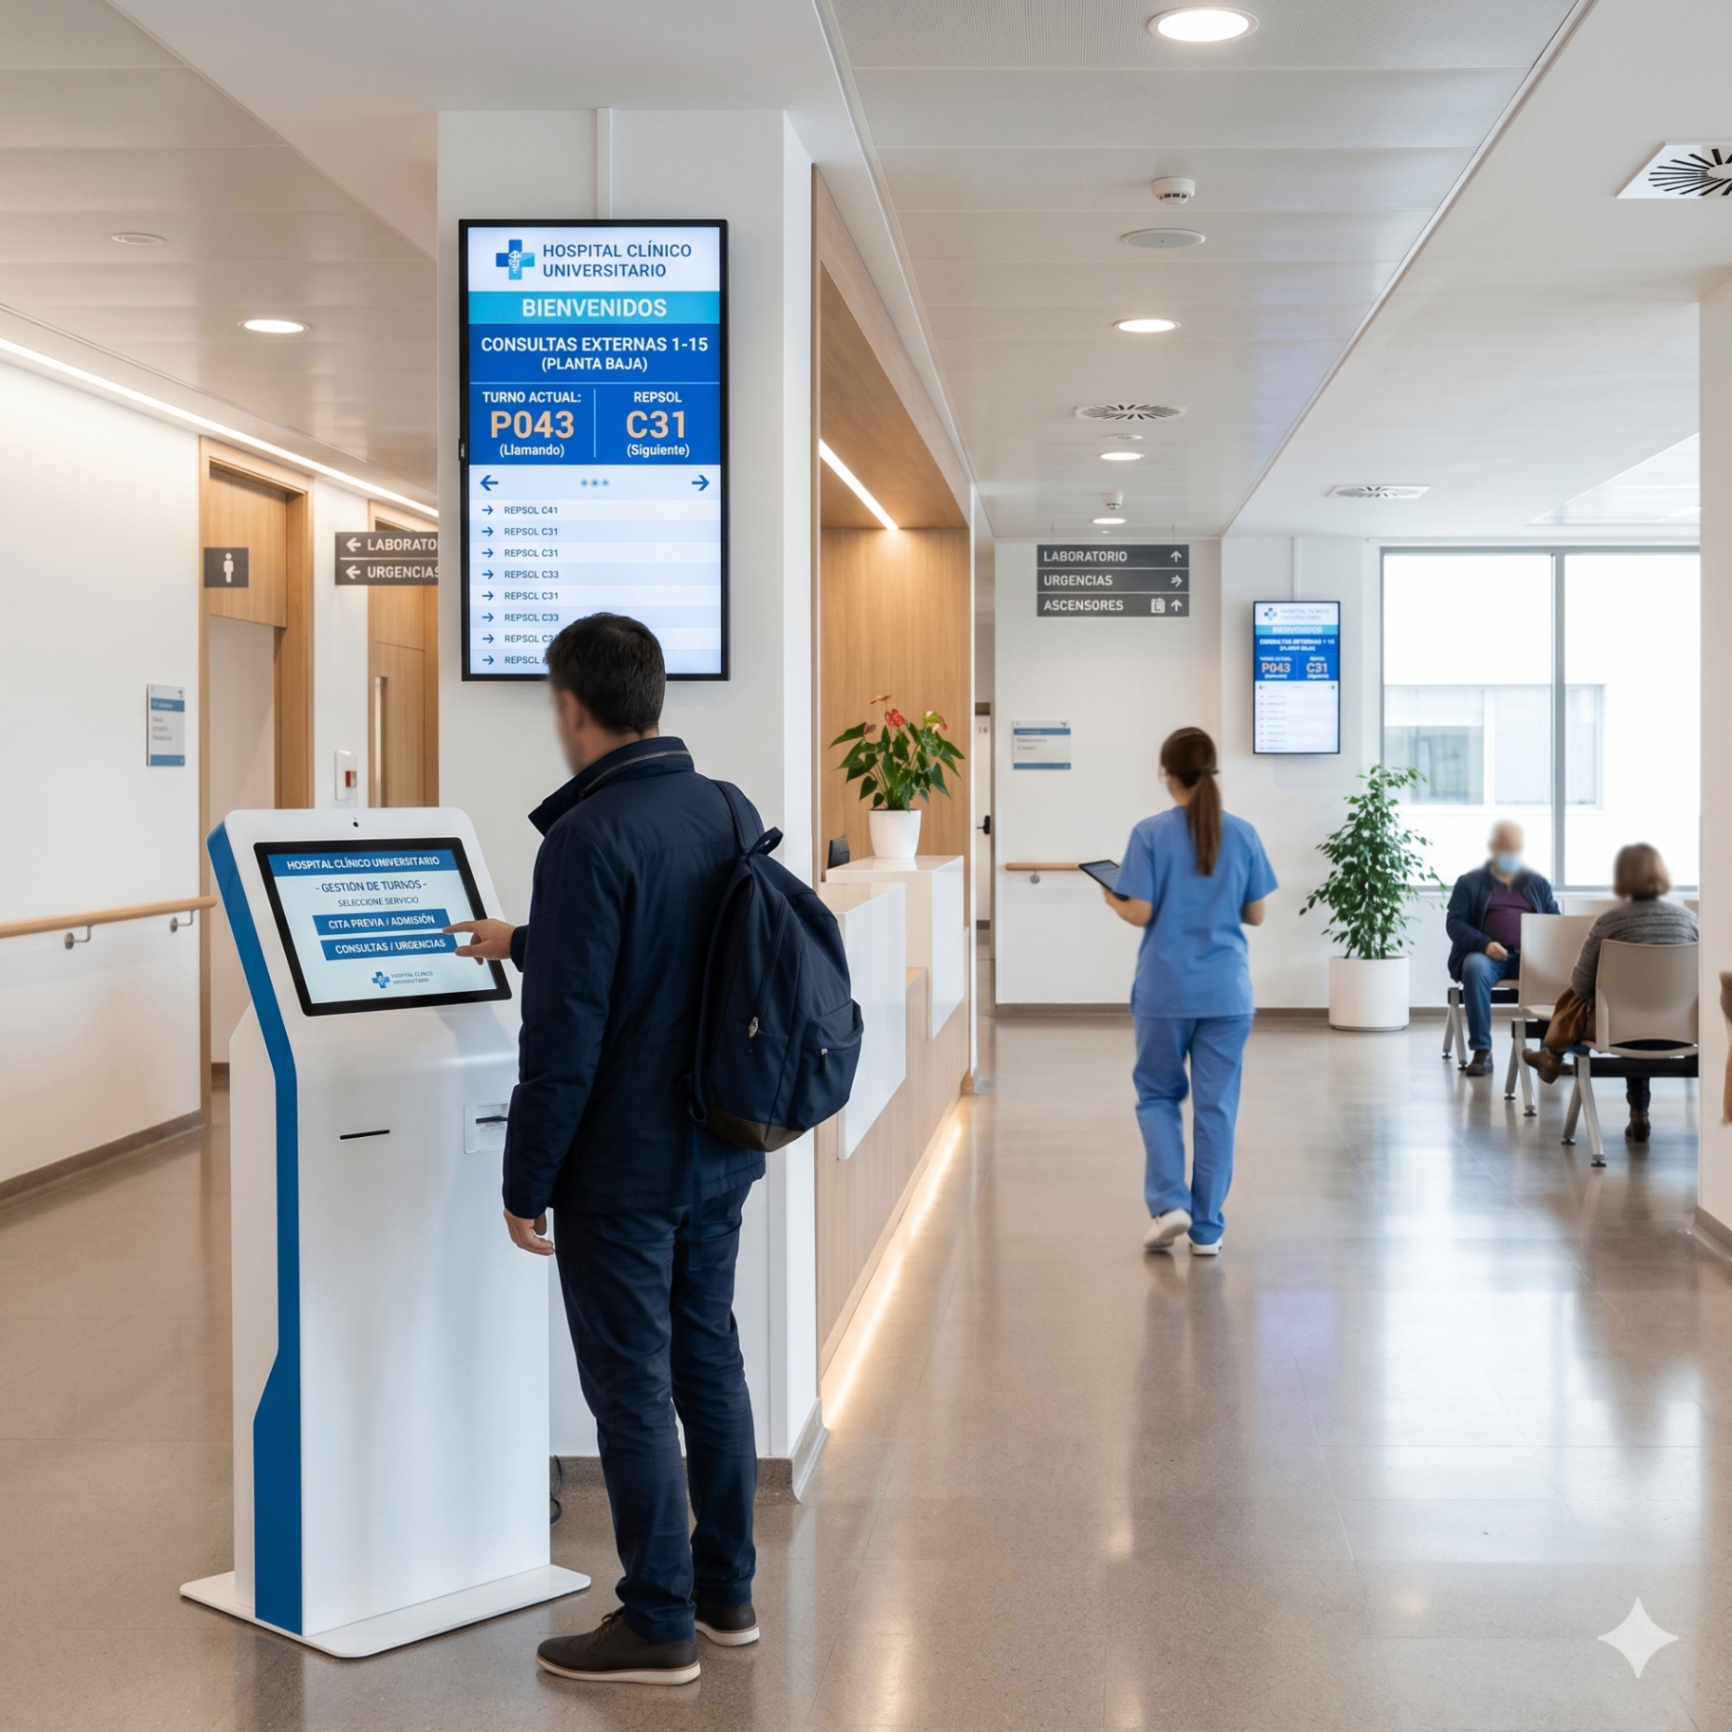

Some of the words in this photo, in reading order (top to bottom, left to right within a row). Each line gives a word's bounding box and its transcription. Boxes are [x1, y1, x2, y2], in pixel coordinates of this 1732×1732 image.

[543, 244, 623, 258] HOSPITAL
[626, 239, 692, 258] CLÍNICO
[543, 263, 667, 277] UNIVERSITARIO
[522, 298, 667, 317] BIENVENIDOS
[481, 337, 578, 352] CONSULTAS
[581, 337, 667, 352] EXTERNAS
[671, 337, 709, 352] 1-15
[541, 357, 602, 373] (PLANTA
[605, 357, 648, 373] BAJA)
[482, 391, 526, 404] TURNO
[528, 391, 582, 404] ACTUAL:
[633, 391, 683, 404] REPSOL
[490, 410, 575, 439] P043
[626, 410, 685, 439] C31
[499, 443, 565, 458] (Llamando)
[626, 443, 690, 458] (Siguiente)
[504, 506, 539, 515] REPSOL
[541, 506, 558, 515] C41
[504, 527, 539, 536] REPSOL
[541, 527, 558, 536] C31
[541, 549, 558, 558] C31
[1043, 551, 1127, 562] LABORATORIO
[541, 570, 559, 579] C33
[1043, 575, 1113, 586] URGENCIAS
[541, 592, 558, 601] C31
[1043, 599, 1124, 611] ASCENSORES
[541, 613, 559, 622] C33
[1261, 662, 1291, 673] P043
[1306, 662, 1328, 673] C31
[287, 860, 334, 870] HOSPITAL
[334, 857, 371, 869] CLÍNICO
[372, 856, 440, 867] UNIVERSITARIO
[366, 881, 380, 892] DE
[381, 880, 422, 891] TURNOS
[338, 898, 383, 908] SELECCIONE
[328, 920, 350, 930] CITA
[351, 918, 385, 929] PREVIA
[391, 913, 436, 926] ADMISIÓN
[335, 943, 388, 954] CONSULTAS
[395, 939, 446, 950] URGENCIAS
